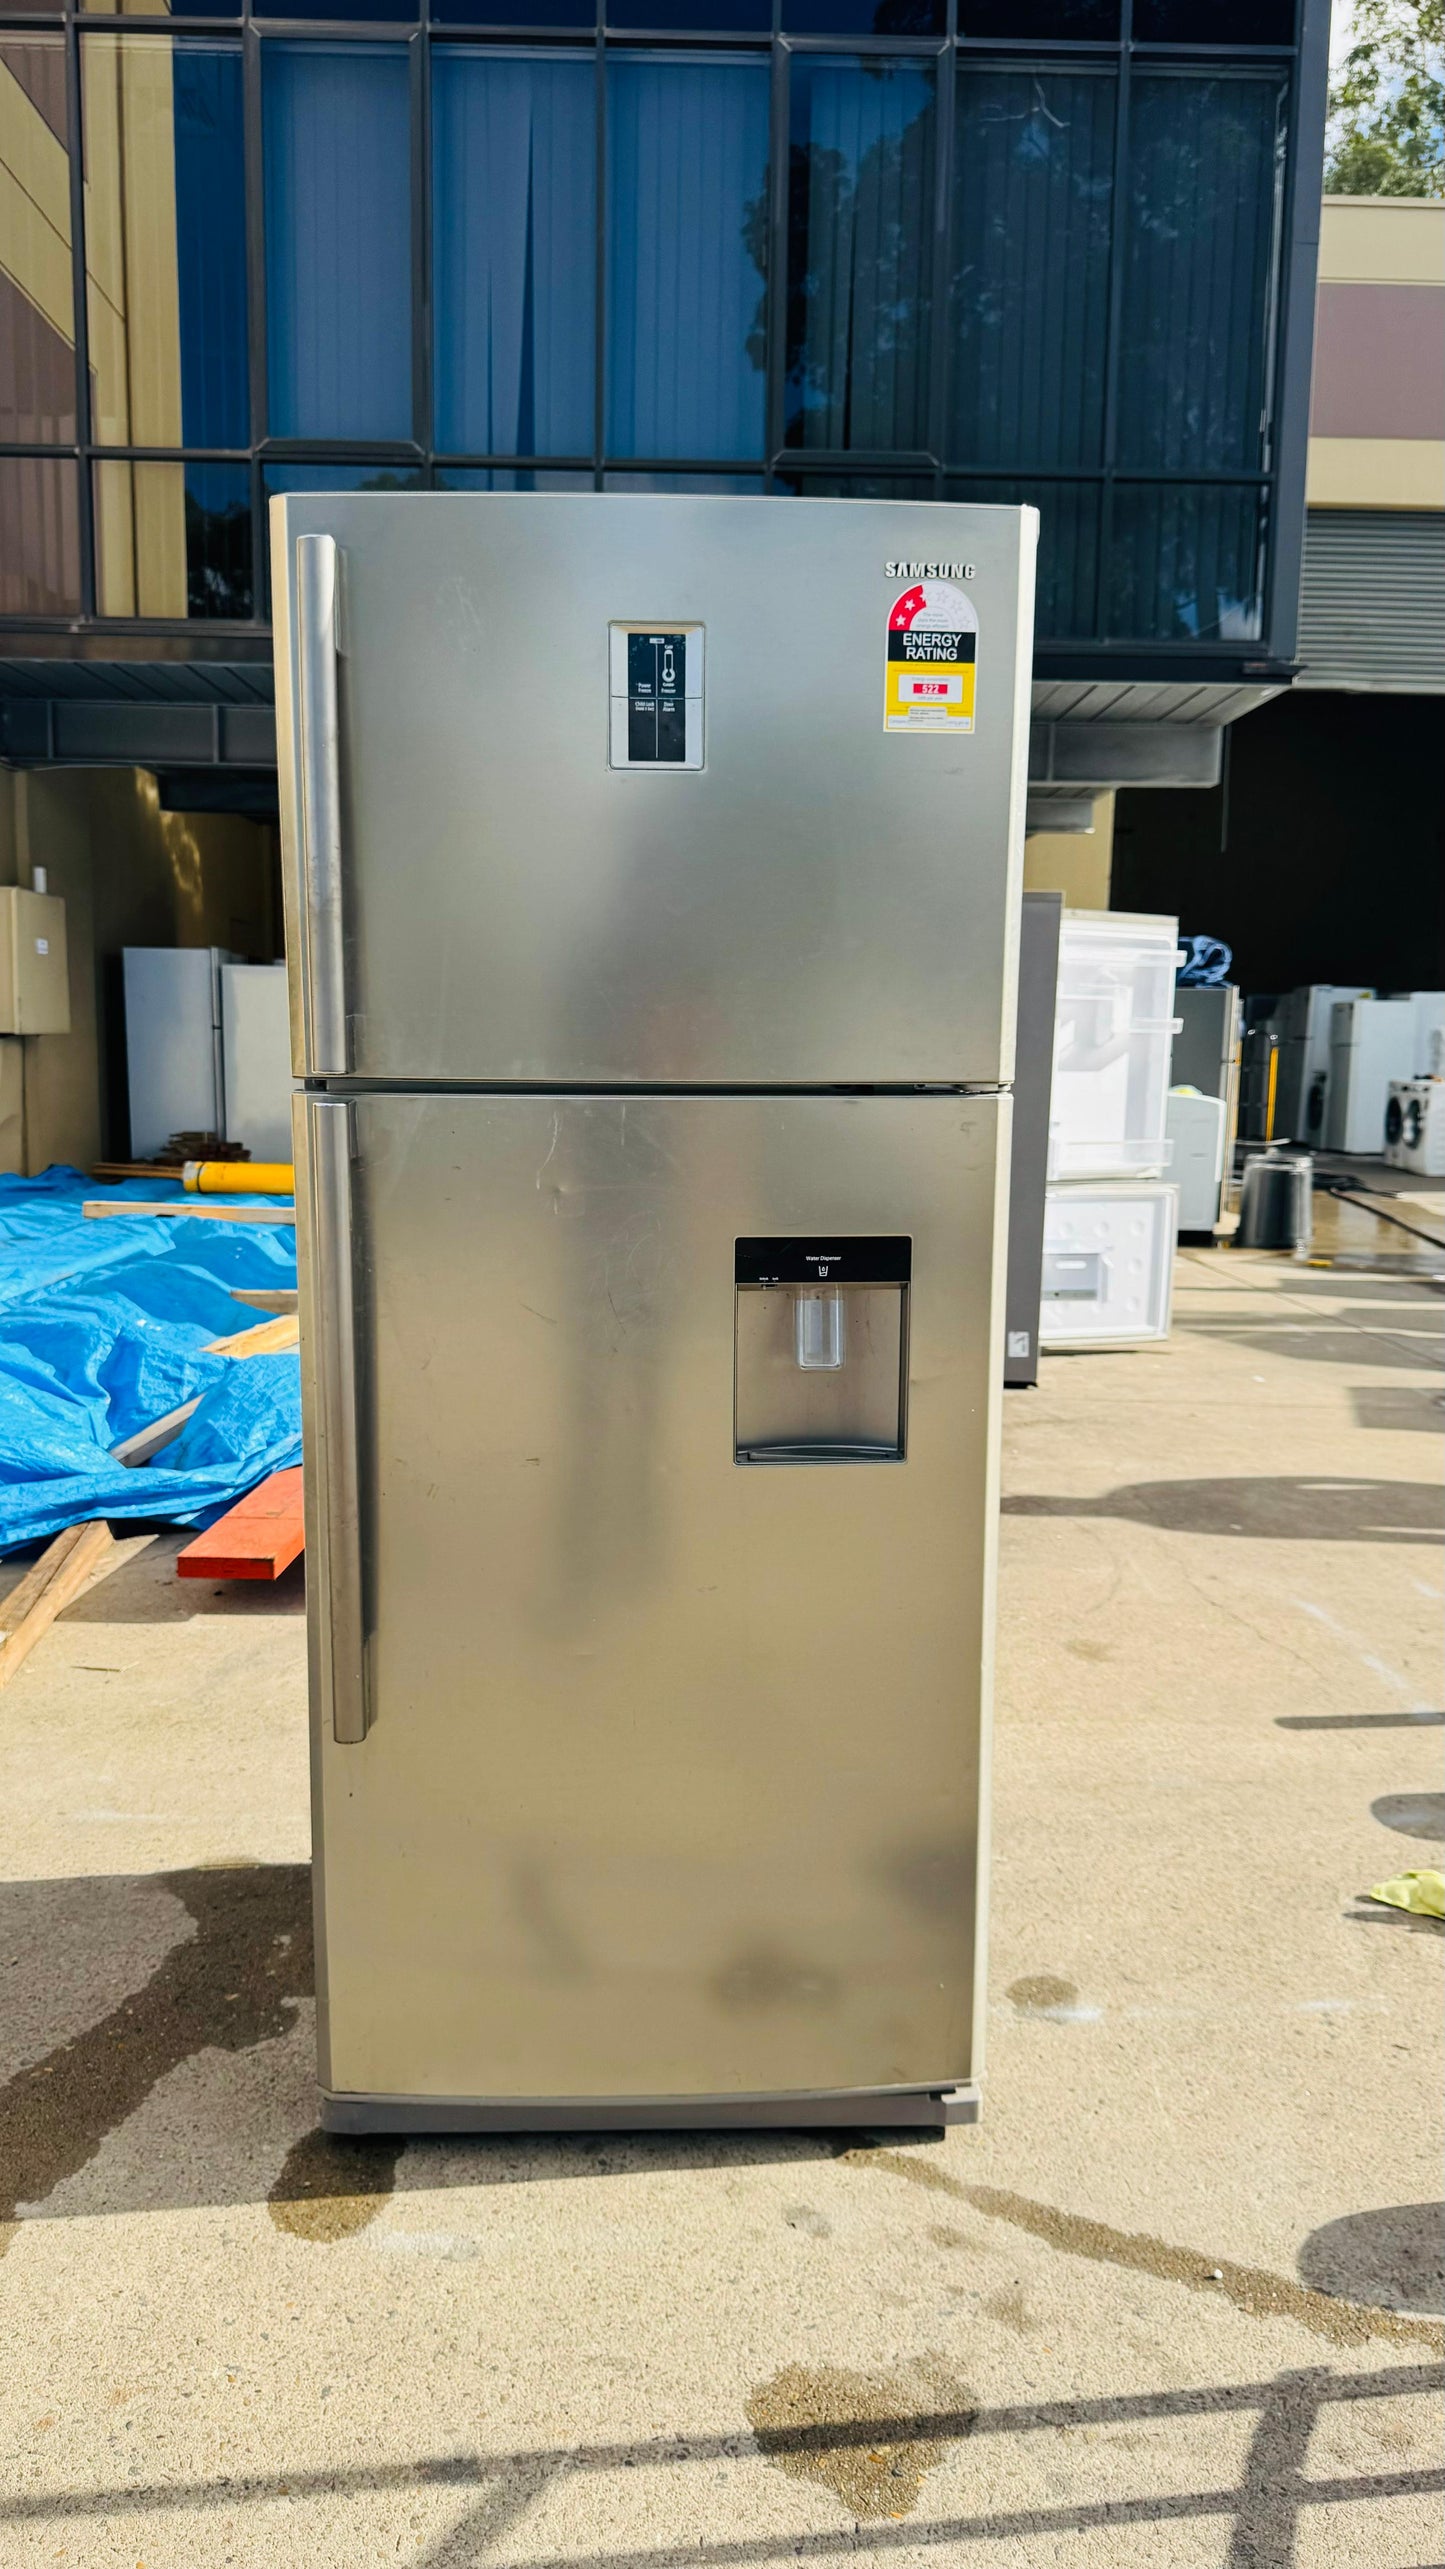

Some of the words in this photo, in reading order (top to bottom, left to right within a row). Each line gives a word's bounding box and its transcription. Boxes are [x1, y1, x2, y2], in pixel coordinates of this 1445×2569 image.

[885, 562, 976, 579] SAMSUNG
[902, 633, 962, 647] ENERGY
[906, 647, 958, 661] RATING
[921, 684, 939, 694] 522
